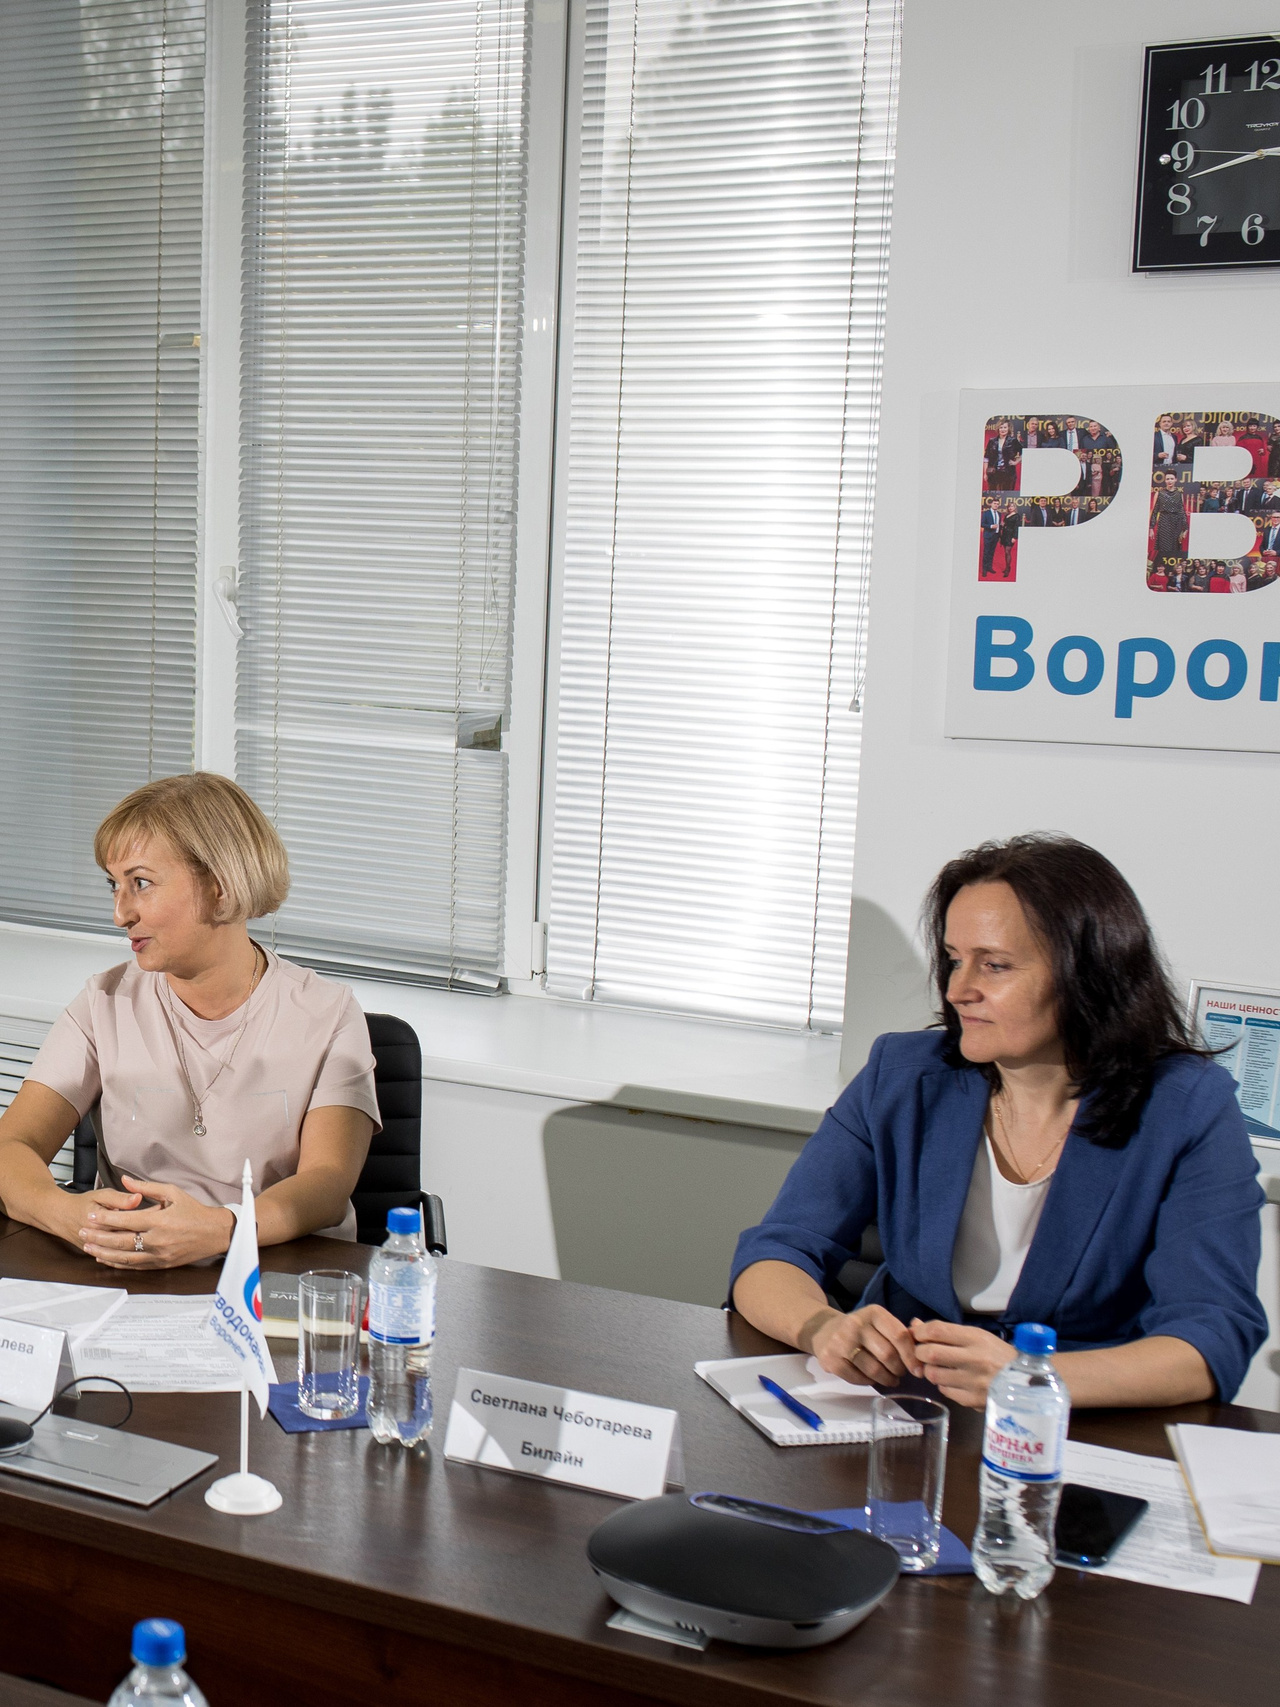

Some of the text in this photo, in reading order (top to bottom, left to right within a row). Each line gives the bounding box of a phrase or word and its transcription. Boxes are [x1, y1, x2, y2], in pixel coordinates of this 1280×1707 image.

[1199, 63, 1231, 95] 11
[1244, 58, 1280, 91] 12
[1166, 98, 1205, 130] 10
[1171, 140, 1195, 173] 9
[1167, 183, 1191, 216] 8
[1197, 215, 1218, 248] 7
[1241, 213, 1265, 246] 6
[1206, 1000, 1236, 1011] НАШИ
[470, 1388, 653, 1441] Светлана Чеботарева
[520, 1440, 585, 1468] Билайн
